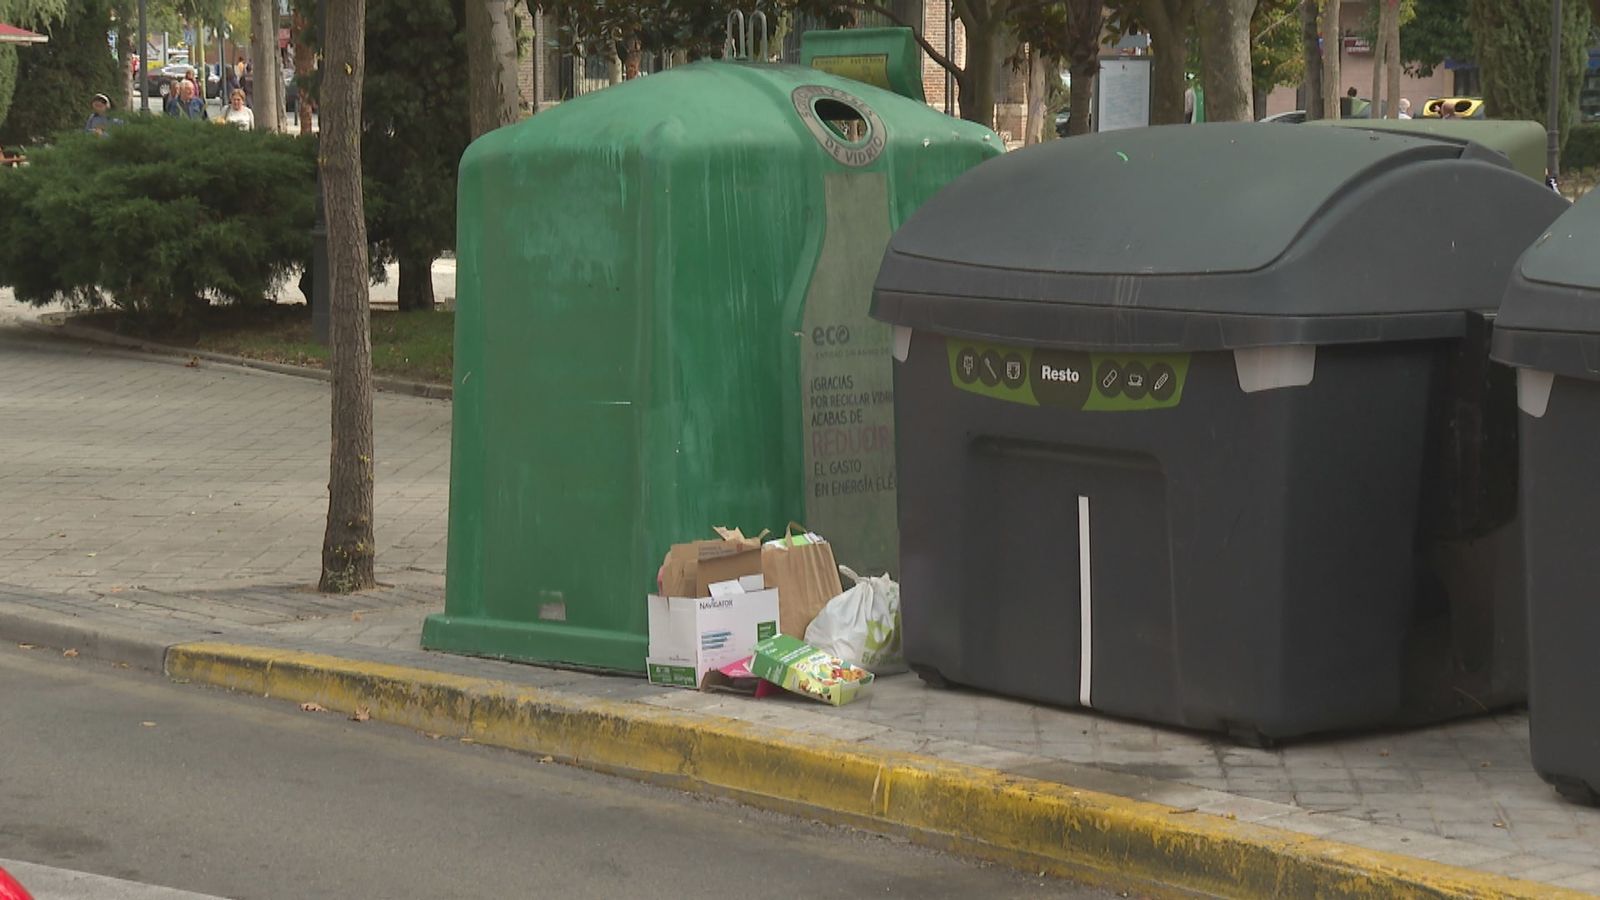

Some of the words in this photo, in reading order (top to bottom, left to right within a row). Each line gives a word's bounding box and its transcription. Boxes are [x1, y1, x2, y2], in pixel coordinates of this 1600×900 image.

[825, 138, 841, 158] DE
[845, 136, 883, 164] VIDRIO
[1041, 365, 1080, 383] Resto
[810, 394, 828, 409] POR
[831, 391, 871, 407] RECICLAR
[811, 410, 848, 427] ACABAS
[849, 408, 863, 424] DE
[812, 424, 891, 457] REDUCIR
[814, 462, 827, 476] EL
[829, 458, 862, 475] GASTO
[815, 482, 829, 498] EN
[699, 598, 734, 610] NAVIGATOR
